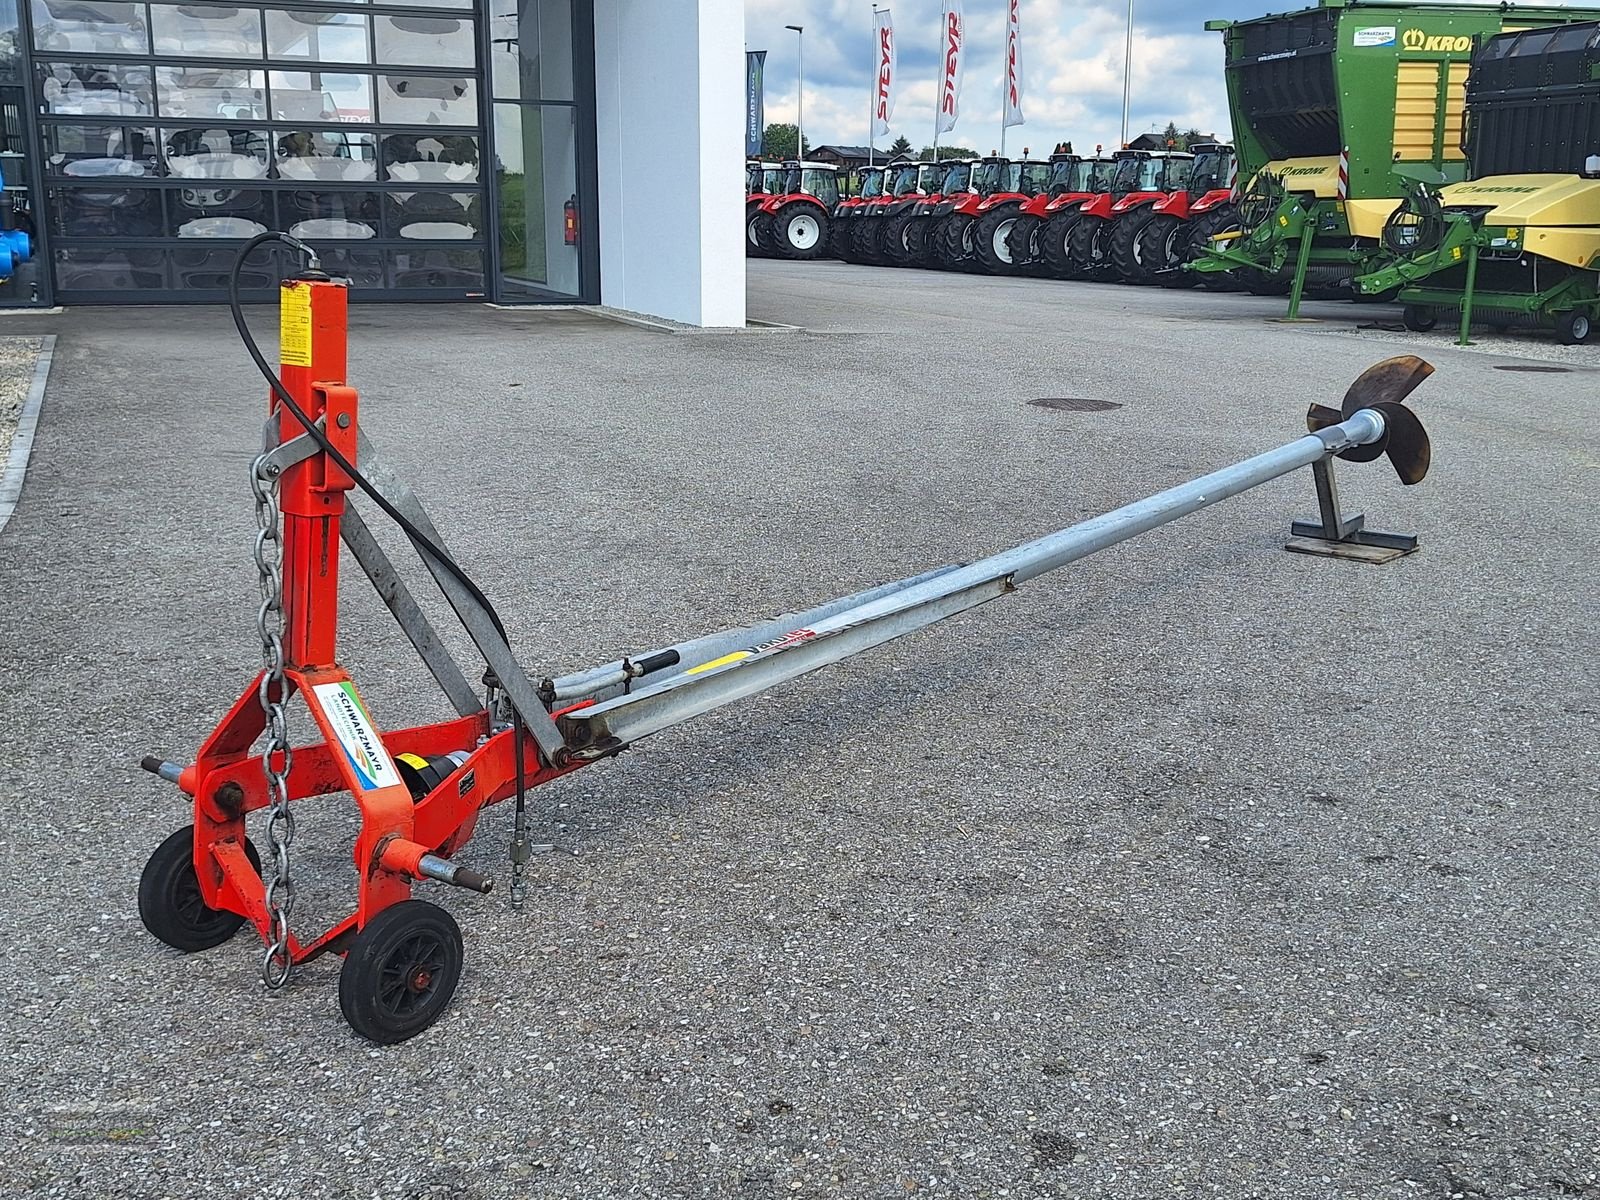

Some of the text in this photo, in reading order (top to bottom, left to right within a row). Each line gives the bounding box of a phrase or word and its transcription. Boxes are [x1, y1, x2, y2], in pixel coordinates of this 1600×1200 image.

[877, 26, 891, 122] STEYR
[943, 11, 959, 117] STEYR
[1289, 166, 1329, 176] KRONE
[1470, 186, 1541, 194] KRONE
[337, 691, 383, 772] SCHWARZMAYR
